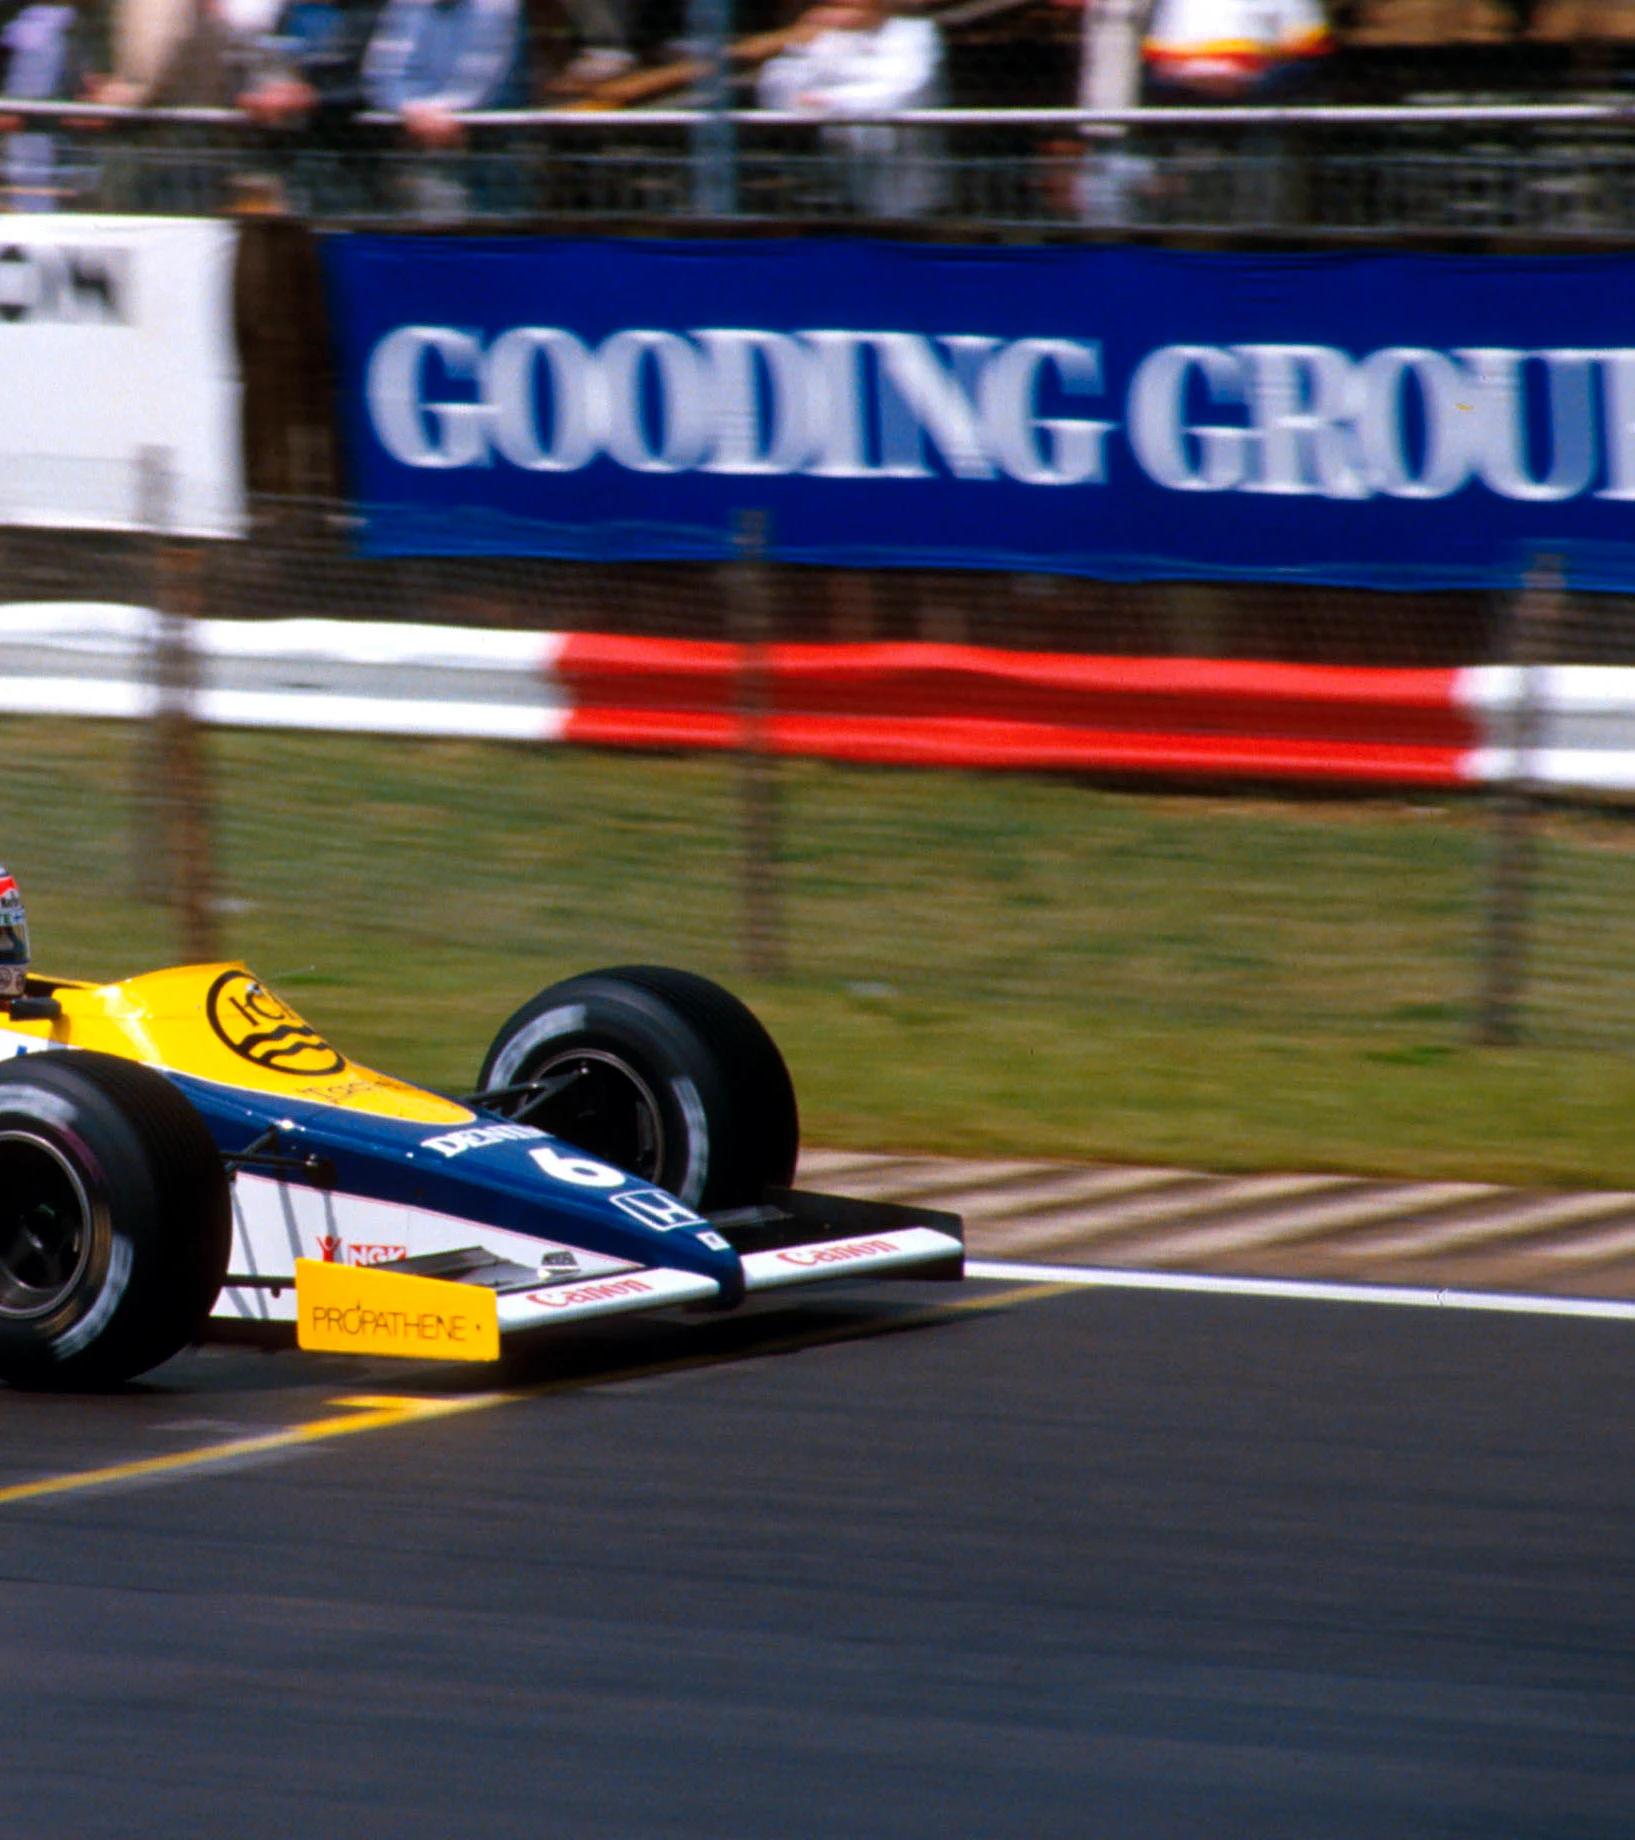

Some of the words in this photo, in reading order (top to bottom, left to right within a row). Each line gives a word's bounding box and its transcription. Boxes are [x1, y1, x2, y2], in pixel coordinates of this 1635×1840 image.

[368, 325, 1117, 485] GOODING
[528, 1148, 626, 1187] 6
[776, 1238, 900, 1267] Canon
[526, 1278, 654, 1308] Canon
[313, 1304, 469, 1342] PROPATHENE
